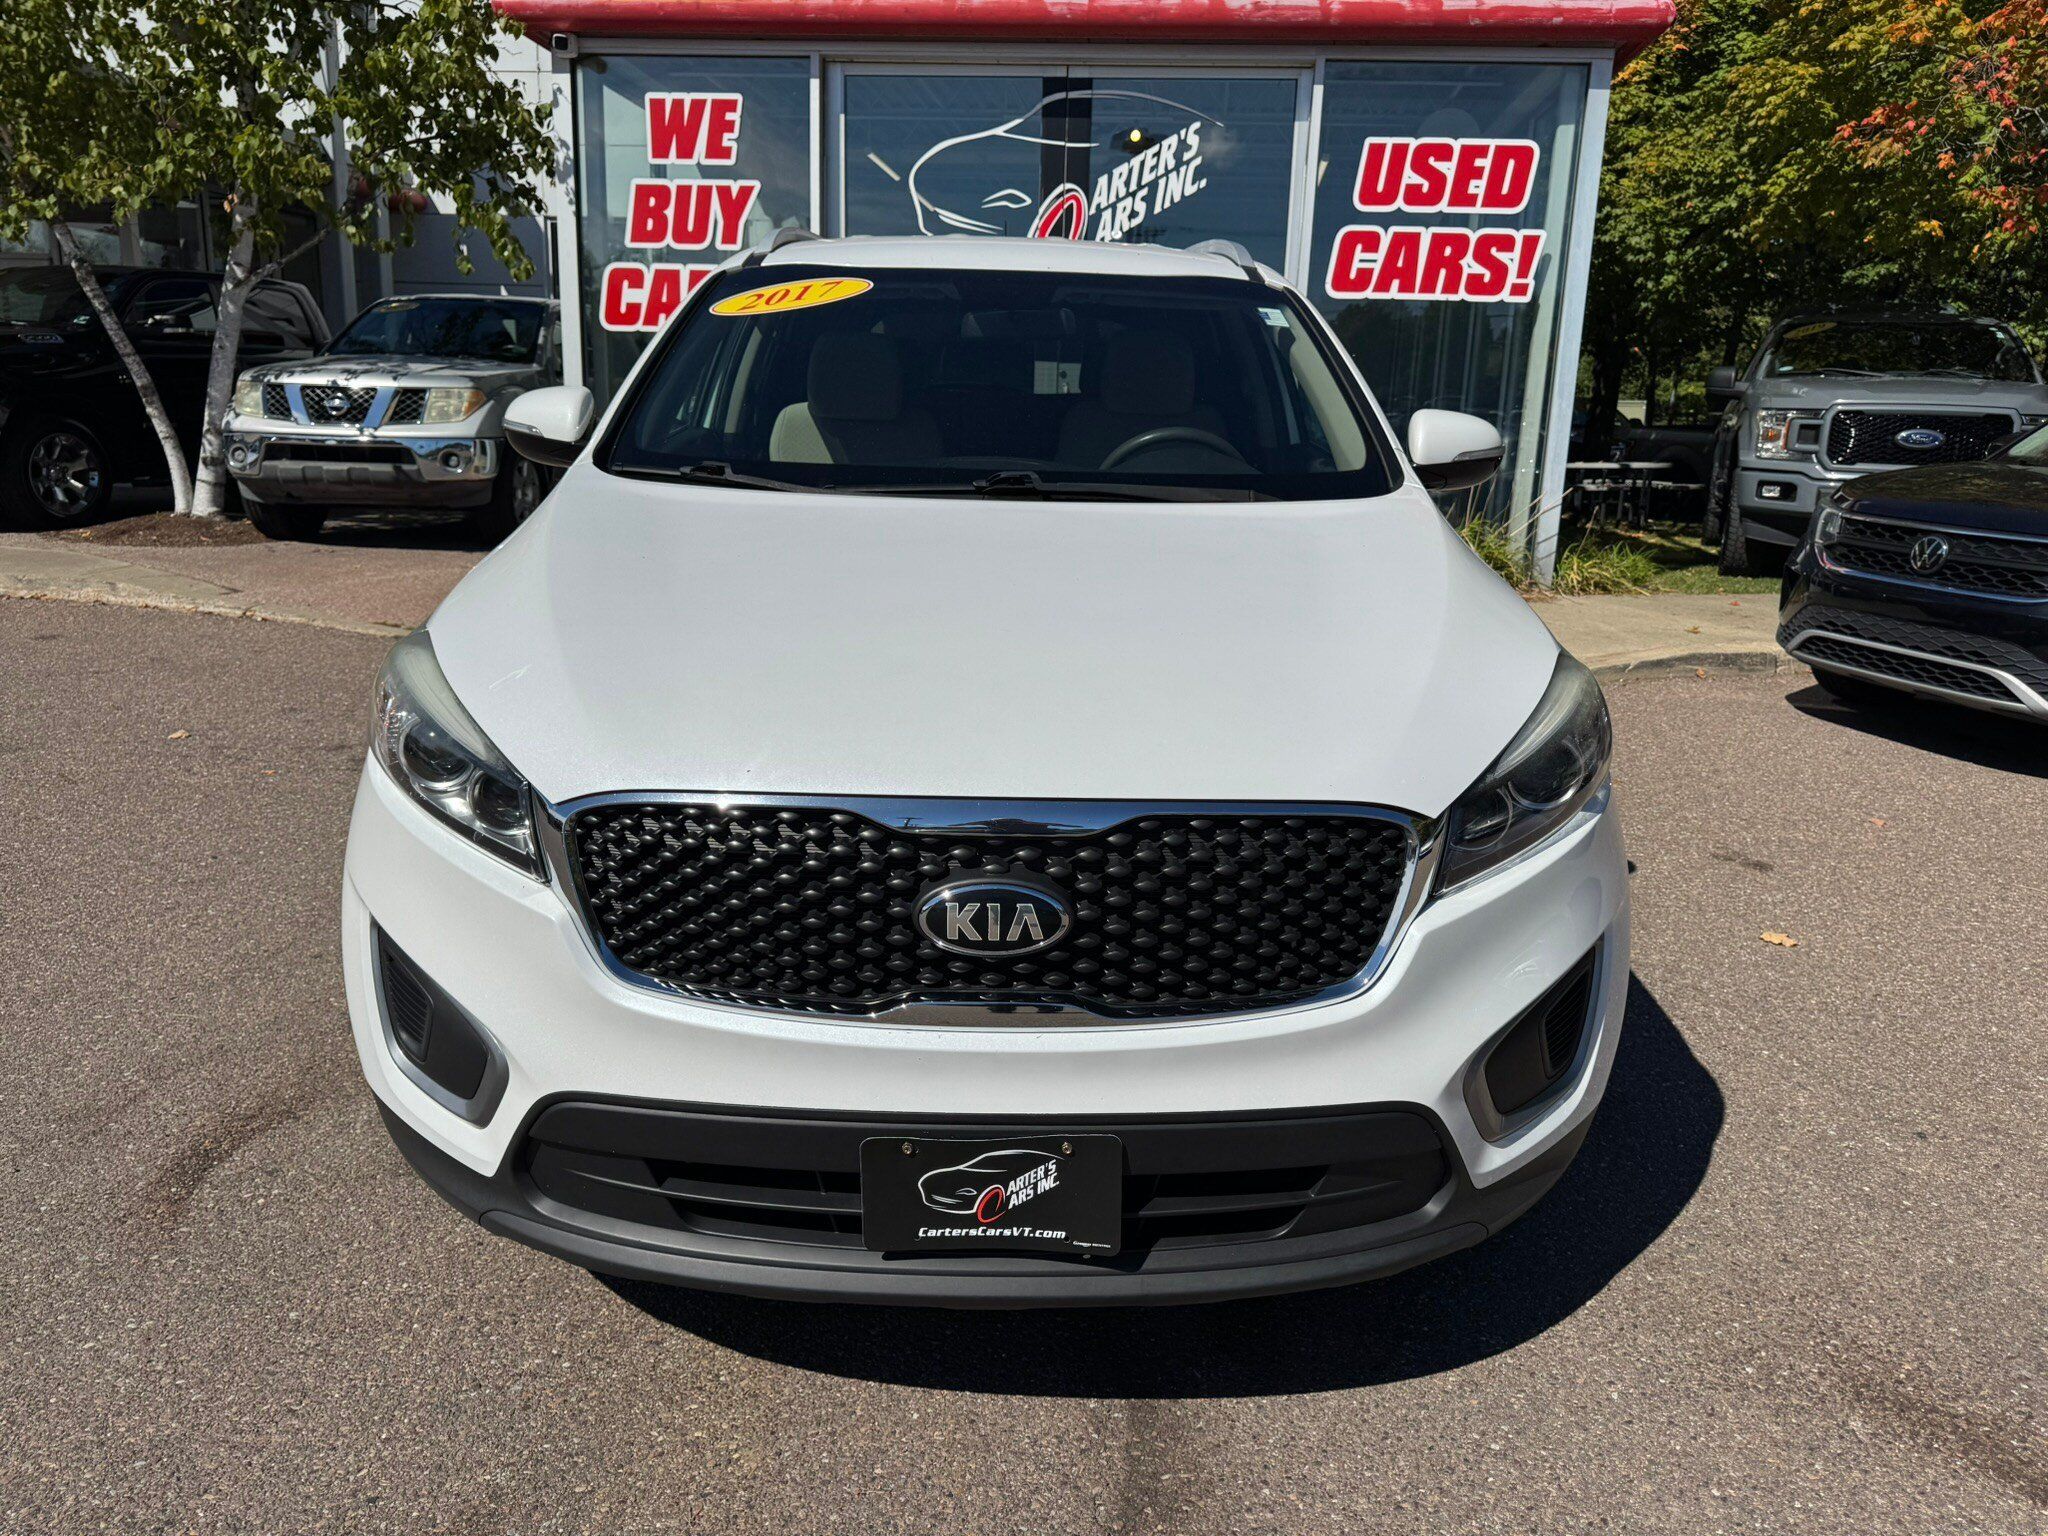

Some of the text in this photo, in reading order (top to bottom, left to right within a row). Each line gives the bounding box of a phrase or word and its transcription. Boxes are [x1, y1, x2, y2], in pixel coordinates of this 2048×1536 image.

[646, 94, 741, 164] WE
[1153, 156, 1207, 215] INC.
[1354, 138, 1539, 213] USED
[626, 179, 760, 249] BUY
[1327, 226, 1546, 301] CARS!
[736, 281, 844, 312] 2017
[945, 902, 1044, 941] KIA
[1037, 1172, 1060, 1194] INC.
[918, 1226, 1066, 1239] CartersCarsVT.com
